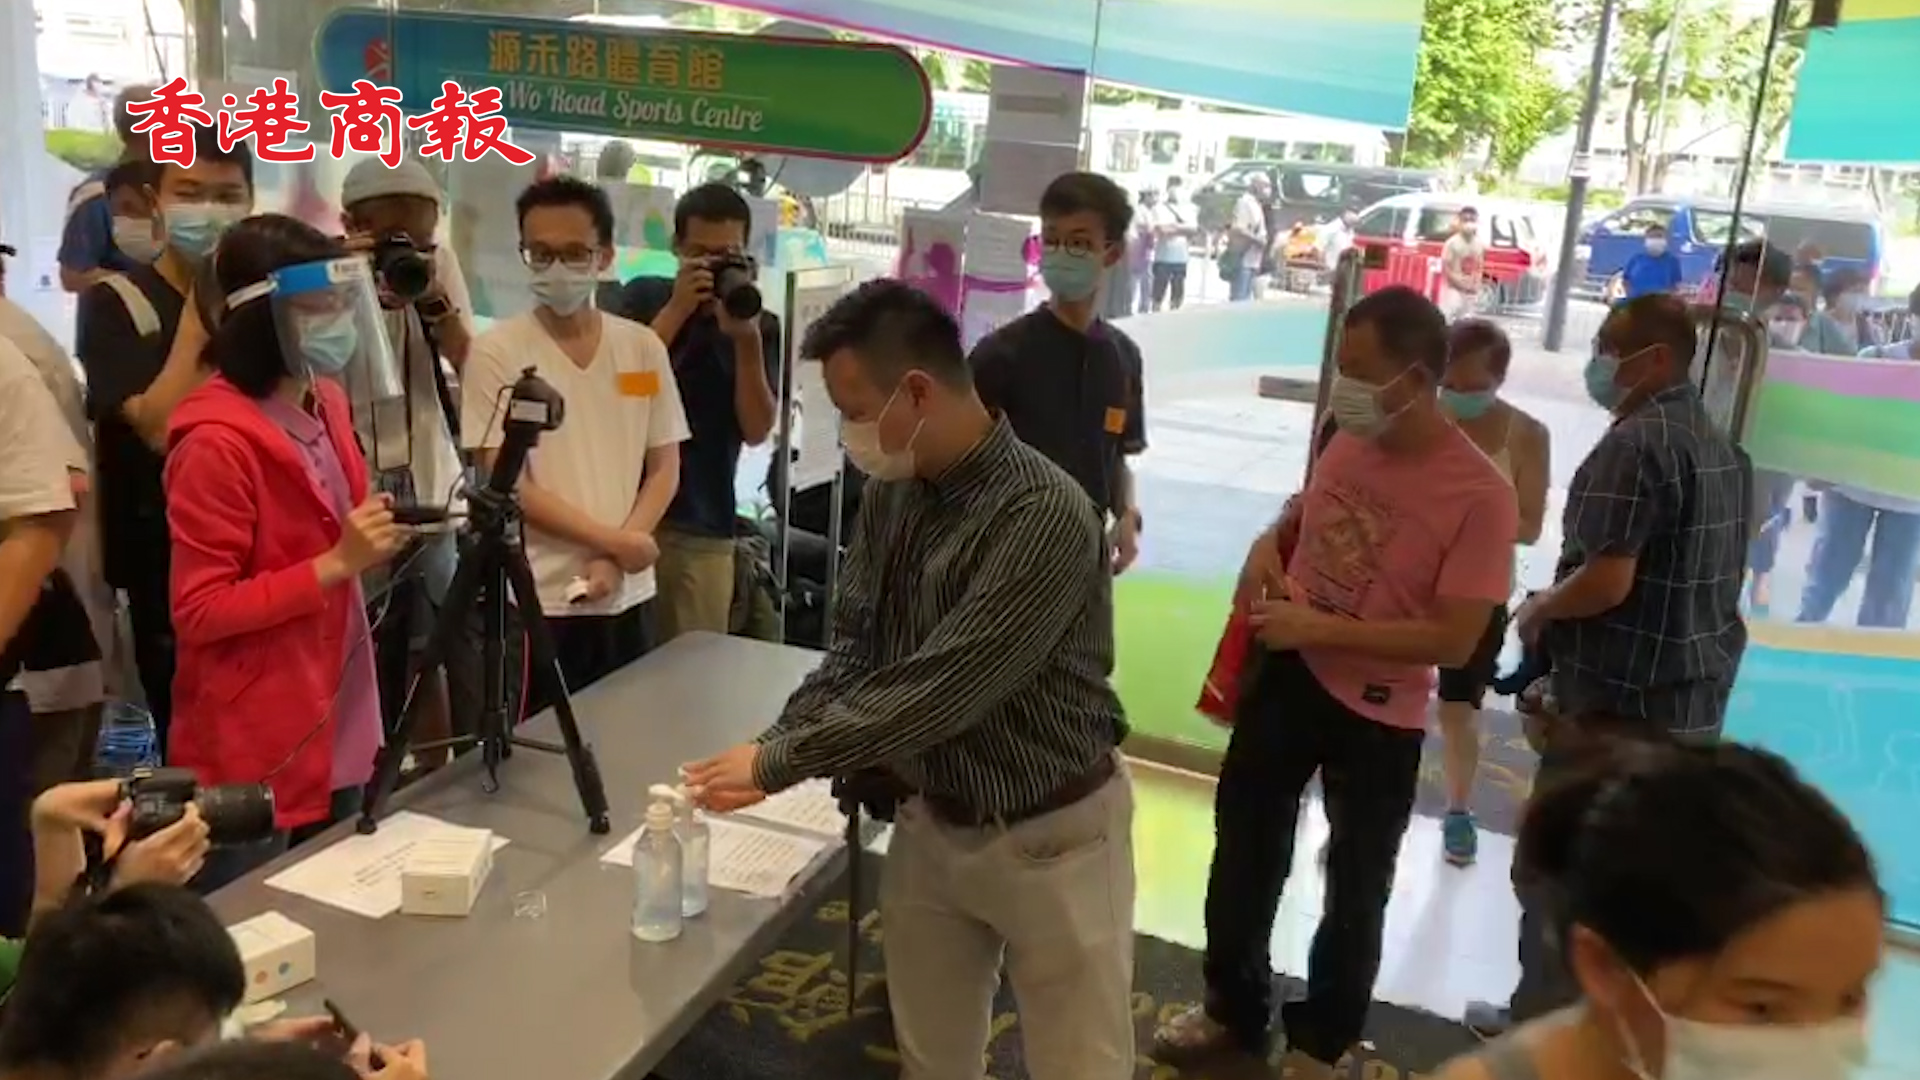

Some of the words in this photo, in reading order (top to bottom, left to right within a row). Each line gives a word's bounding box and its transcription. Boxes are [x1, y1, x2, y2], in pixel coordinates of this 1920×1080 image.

[488, 29, 724, 90] 源禾路體育館
[503, 79, 541, 112] Wo
[548, 84, 607, 117] Road
[612, 90, 684, 127] Sports
[690, 96, 765, 132] Centre
